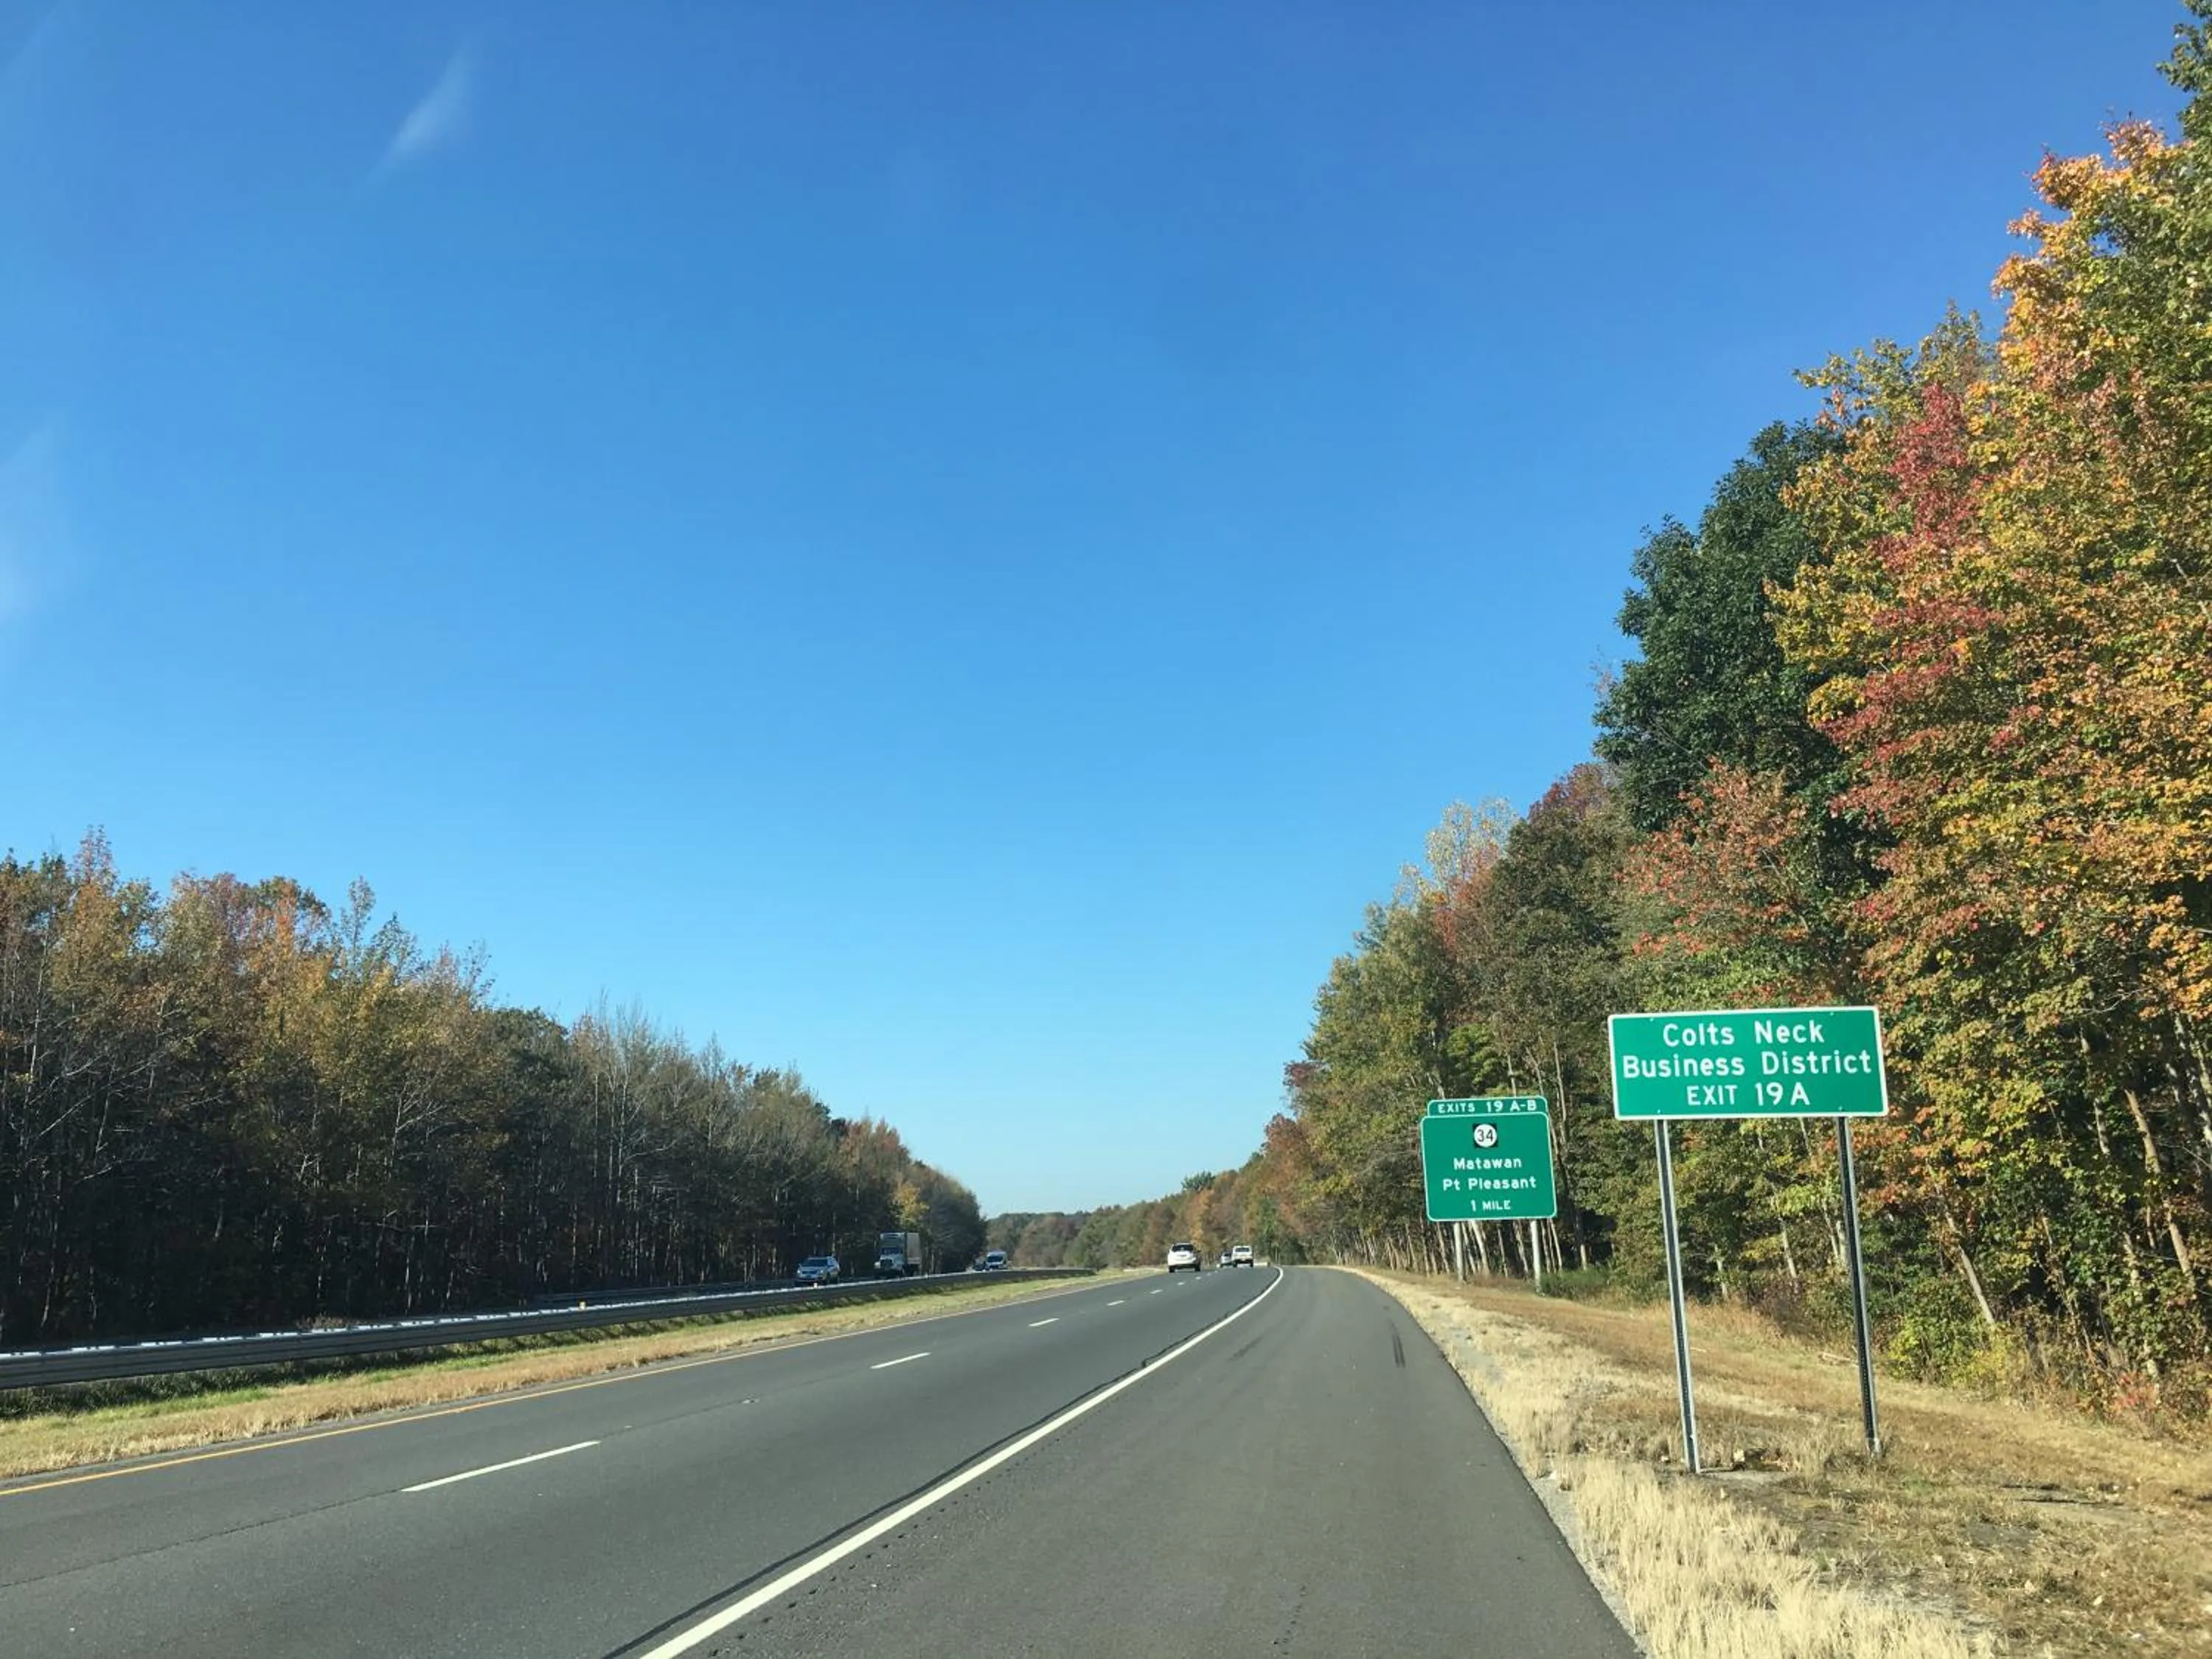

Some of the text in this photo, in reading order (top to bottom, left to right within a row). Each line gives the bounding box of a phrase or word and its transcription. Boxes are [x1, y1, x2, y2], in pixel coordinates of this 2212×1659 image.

[1663, 1020, 1824, 1047] Colts Neck
[1623, 1050, 1871, 1078] Business District
[1686, 1085, 1738, 1106] EXIT
[1438, 1104, 1475, 1113] EXITS
[1486, 1101, 1503, 1112] 19
[1477, 1129, 1494, 1142] 34
[1453, 1157, 1522, 1170] Matawan
[1442, 1176, 1537, 1191] Pt Pleasant
[1470, 1200, 1511, 1211] 1 MILE
